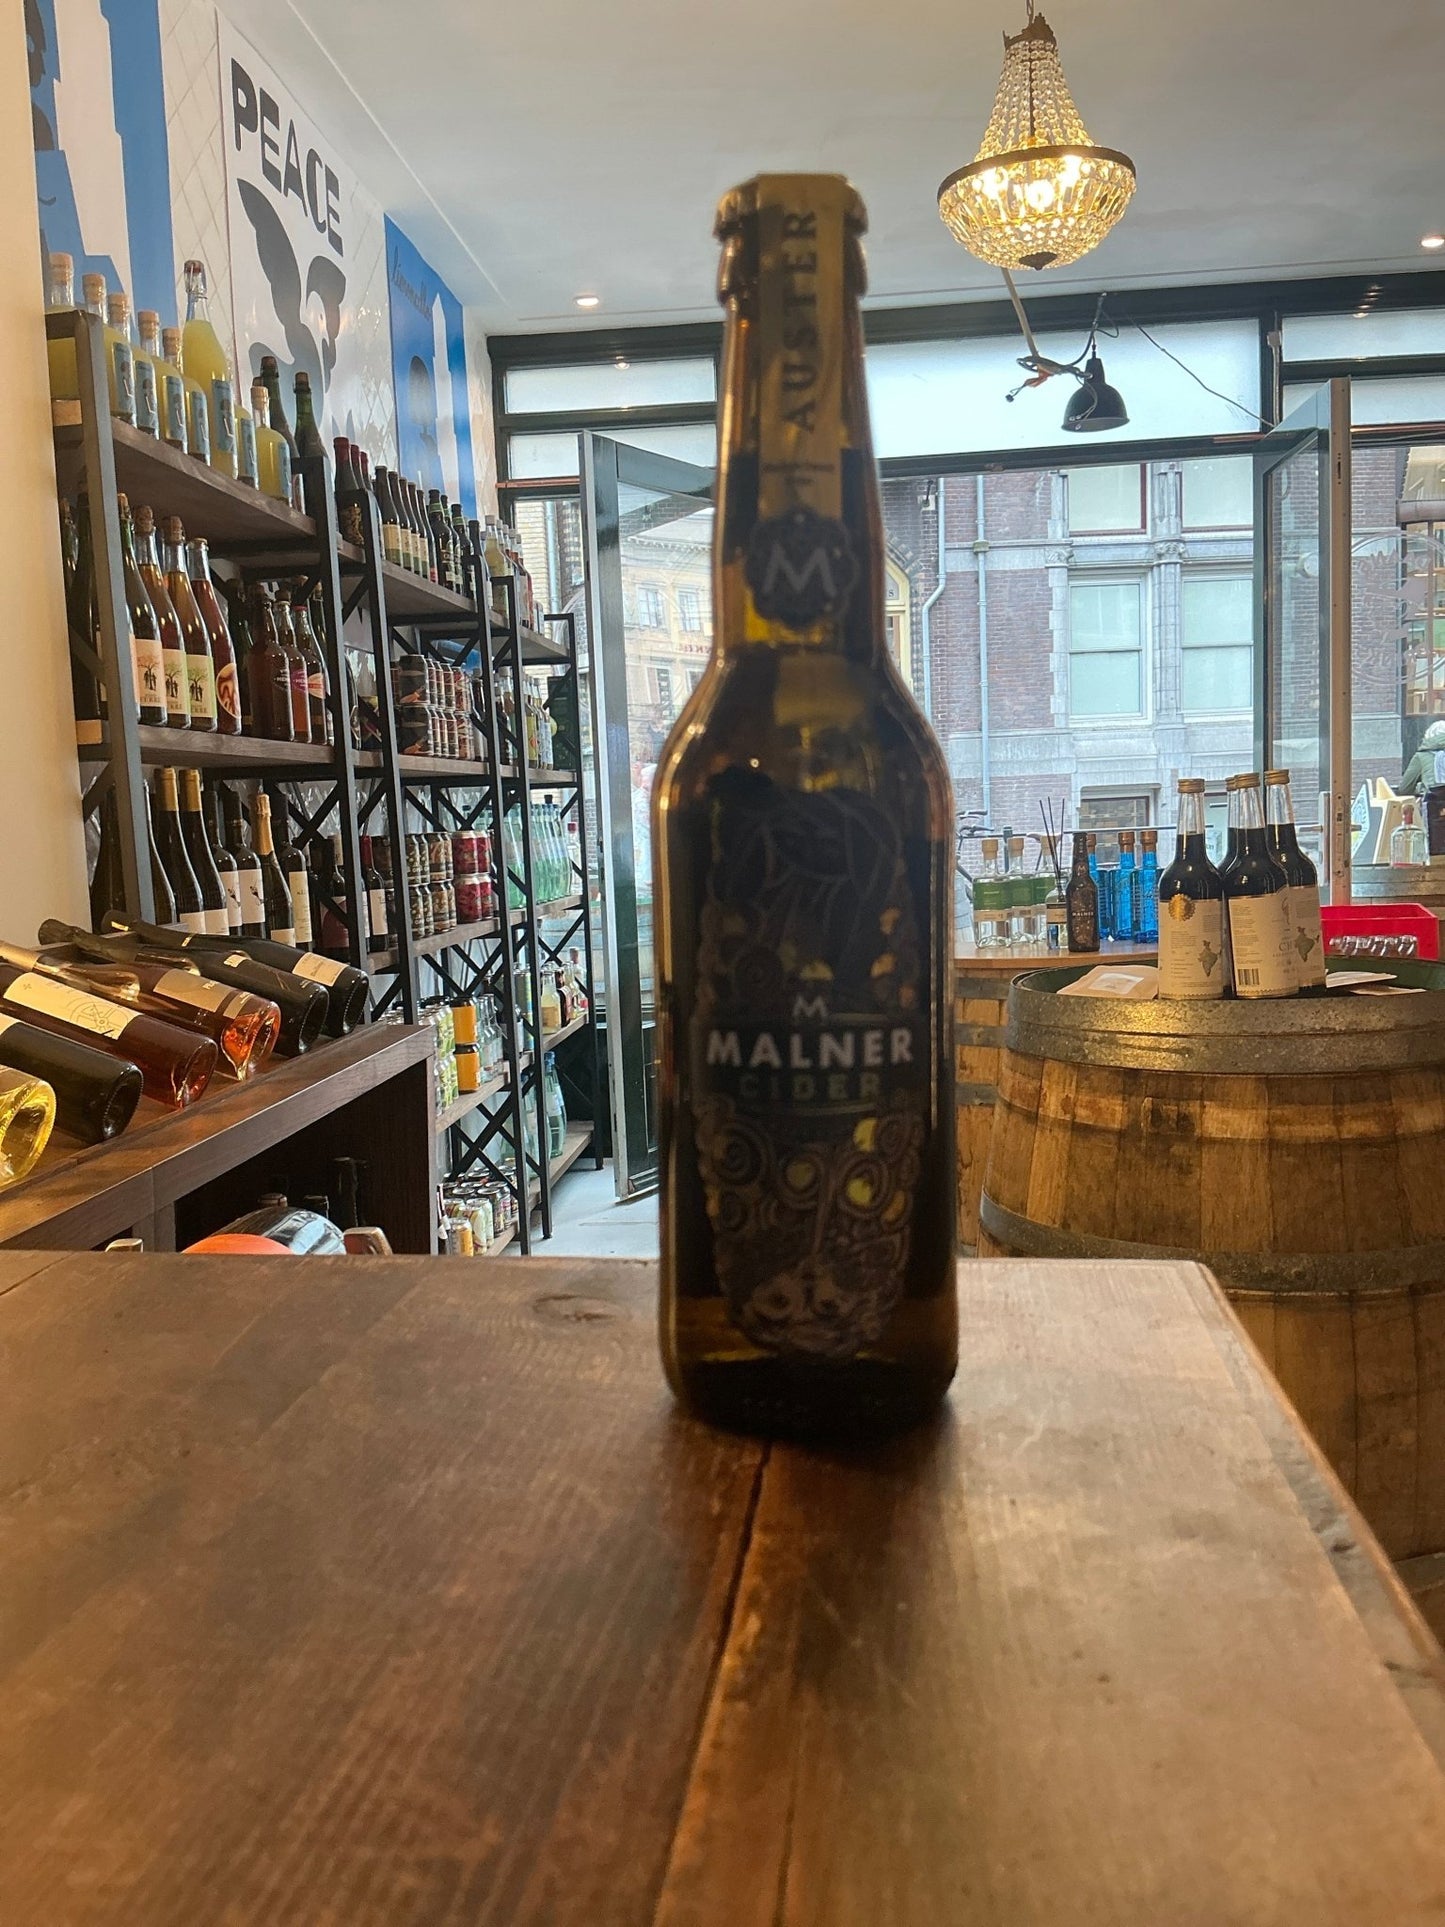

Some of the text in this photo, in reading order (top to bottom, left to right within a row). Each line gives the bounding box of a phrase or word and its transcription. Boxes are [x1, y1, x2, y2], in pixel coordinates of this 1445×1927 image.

[231, 57, 344, 257] PEACE
[706, 1028, 914, 1068] MALNER
[740, 1073, 881, 1100] CIDER
